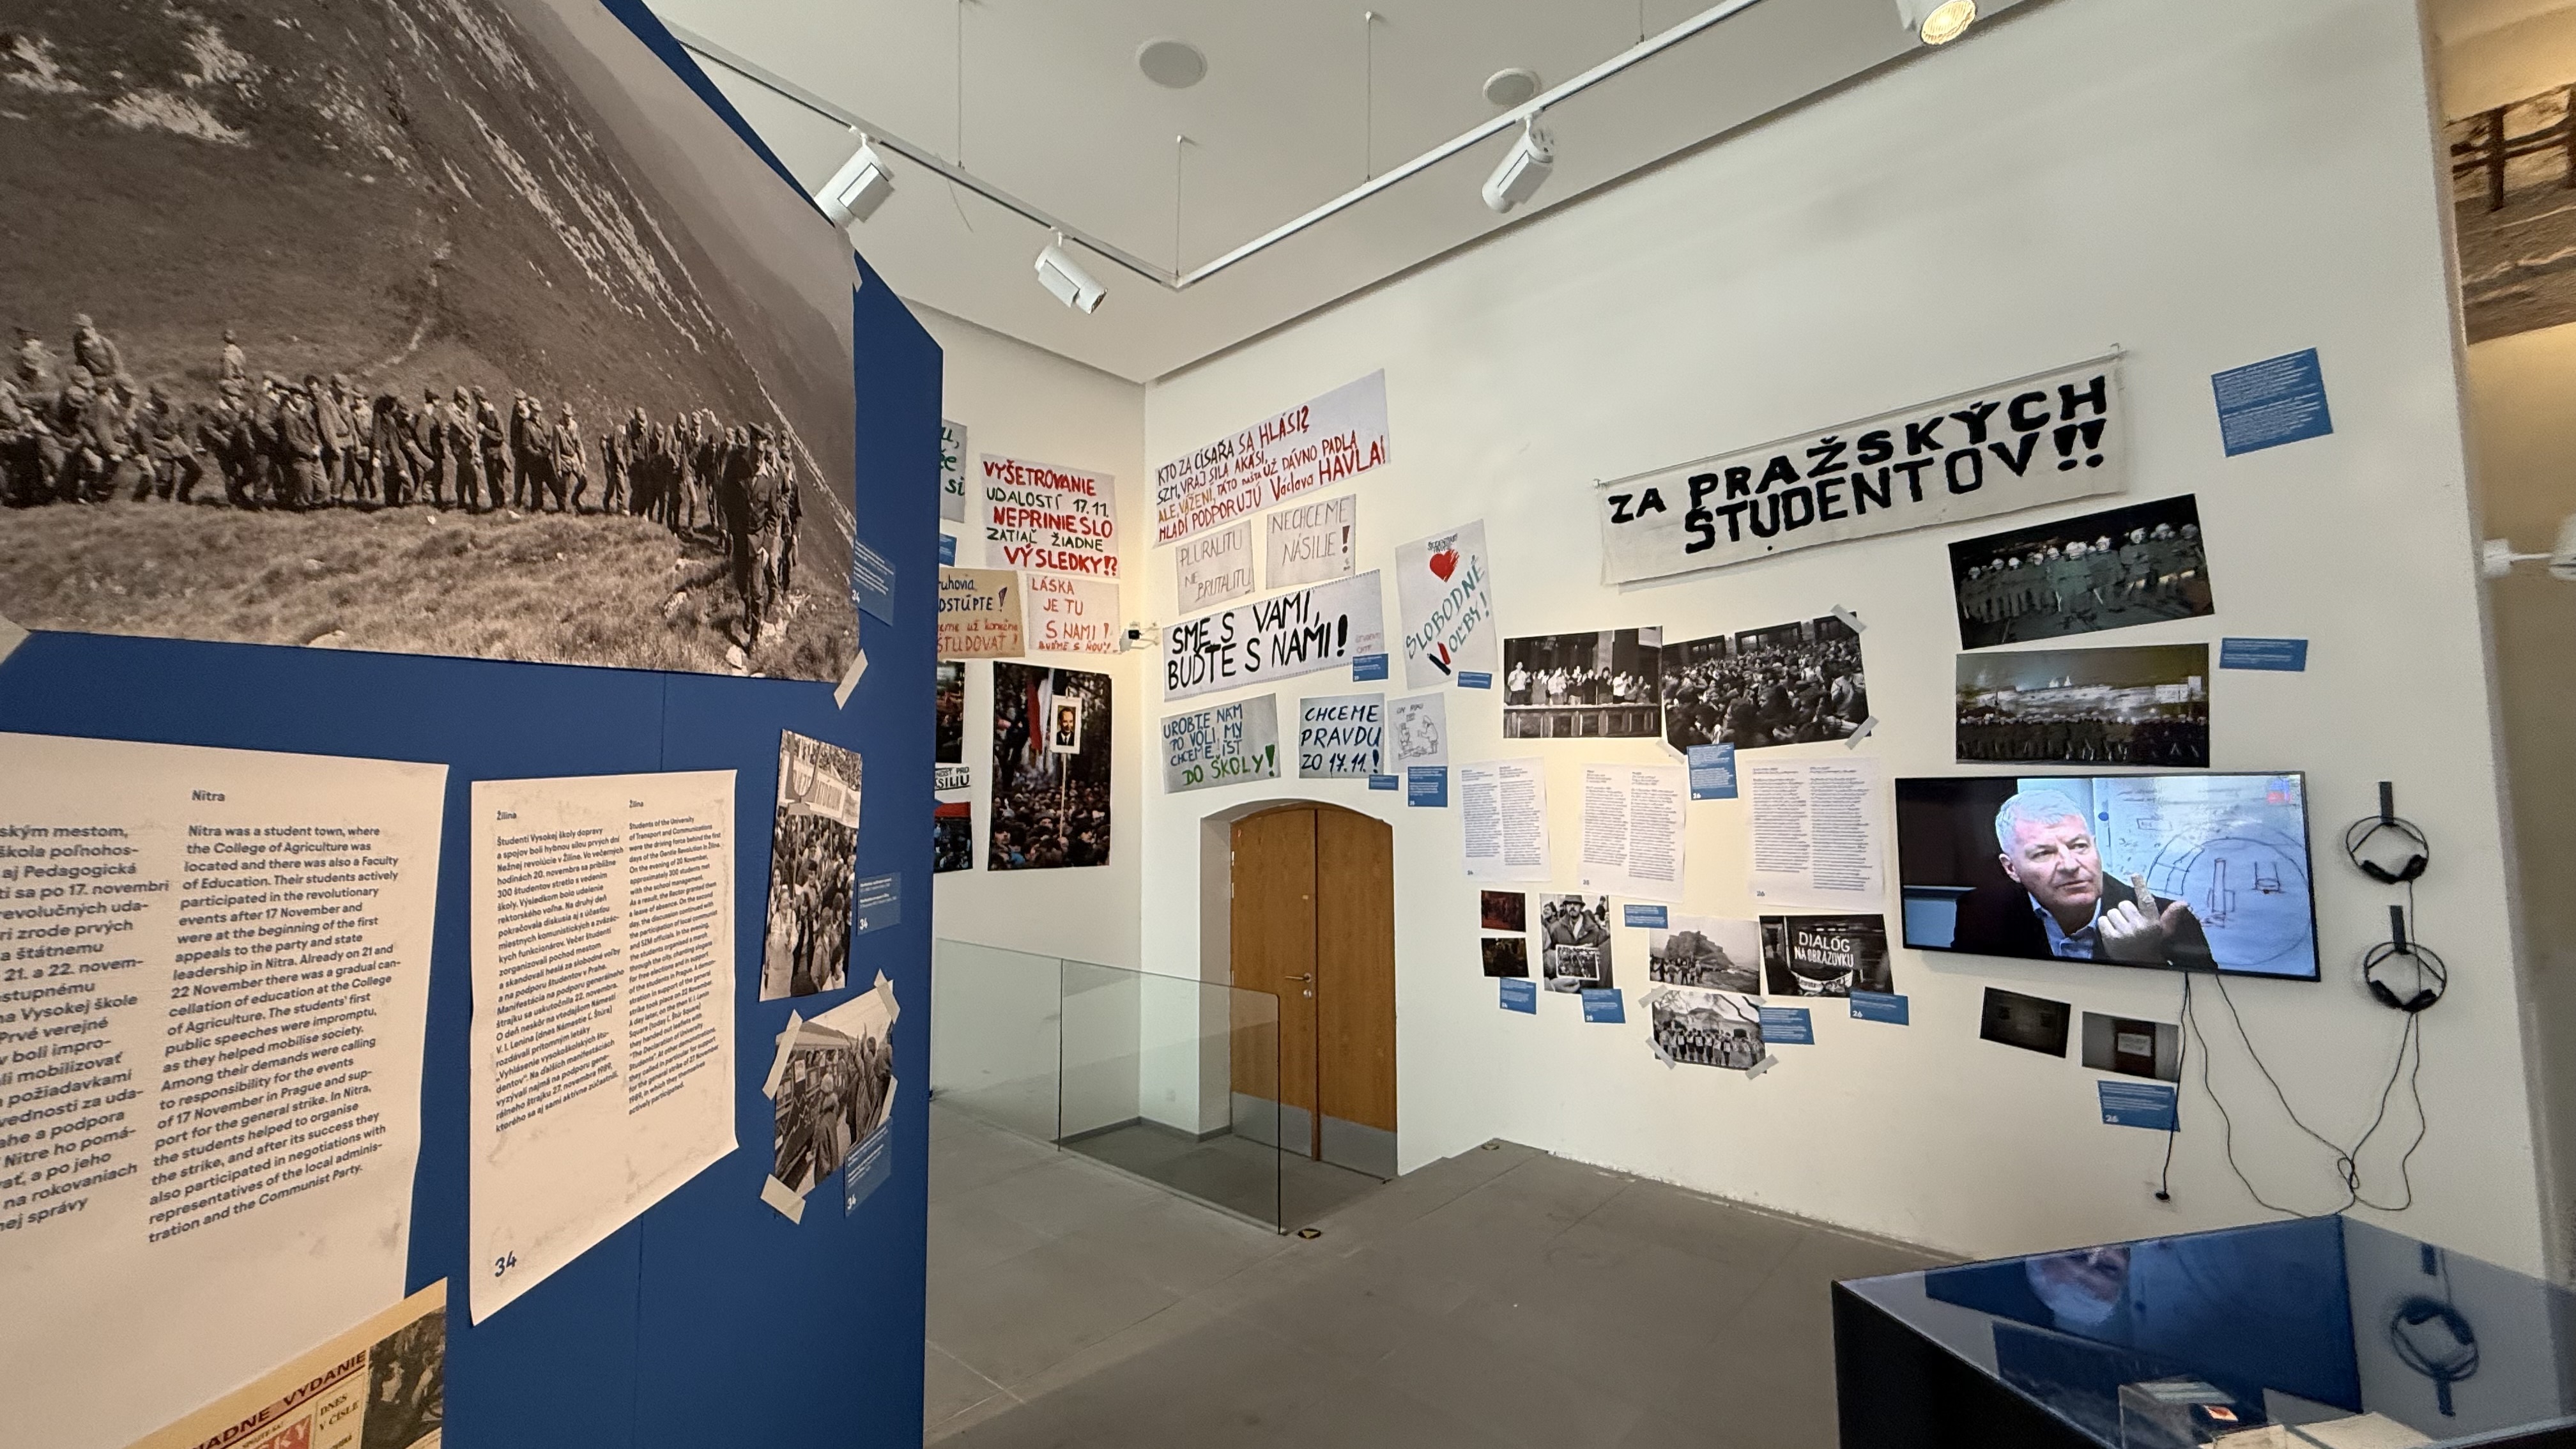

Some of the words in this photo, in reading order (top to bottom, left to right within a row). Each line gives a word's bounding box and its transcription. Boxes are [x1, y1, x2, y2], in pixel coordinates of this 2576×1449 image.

[1158, 463, 1176, 486] KTO
[1179, 457, 1192, 477] ZA
[1239, 431, 1255, 454] SA
[1259, 405, 1309, 448] HLÁSI?
[1607, 487, 1667, 523] ZA
[1689, 375, 2107, 507] PRAŽSKÝCH
[1217, 479, 1238, 496] TÁTO
[1282, 448, 1317, 471] DÁVNO
[1322, 429, 1358, 457] PADLA
[983, 459, 1096, 496] VYŠETROVANIE
[1158, 515, 1188, 542] MLADÍ
[1192, 481, 1262, 530] PODPORUJÚ
[1269, 471, 1314, 501] Václava
[1319, 434, 1386, 486] HAVLA!
[1181, 471, 1206, 494] VRAJ
[1209, 463, 1229, 482] SILA
[987, 487, 1062, 510] UDALOSTÍ
[1272, 497, 1350, 533] NECHCEME
[986, 527, 1038, 544] ZATIAĽ
[1051, 532, 1103, 552] ŽIADNE
[1180, 529, 1242, 567] PLURALITU
[1032, 576, 1075, 595] LÁSKA
[1185, 571, 1199, 587] NE
[939, 594, 993, 613] DSTÚPTE
[1043, 598, 1059, 612] JE
[1064, 598, 1084, 616] TU
[1406, 554, 1485, 659] SLOBODNÉ
[940, 624, 959, 632] eme
[1046, 620, 1057, 639] S
[1064, 622, 1095, 640] NAMI
[1172, 617, 1211, 655] SME
[1220, 612, 1235, 643] S
[1245, 638, 1261, 672] S
[1305, 705, 1379, 722] CHCEME
[1163, 712, 1211, 739] UROBTE
[1170, 737, 1184, 751] PO
[1301, 726, 1381, 748] PRAVDU
[1301, 754, 1322, 770] ZO
[1182, 764, 1204, 786] DO
[192, 790, 226, 802] Nitra
[496, 810, 517, 820] Žilina
[629, 820, 654, 830] Students
[0, 824, 49, 841] ským
[53, 826, 128, 838] mestom,
[188, 825, 222, 836] Nitra
[225, 828, 250, 836] was
[253, 828, 261, 836] a
[263, 826, 312, 836] student
[314, 827, 346, 838] town,
[348, 826, 380, 836] where
[497, 836, 529, 847] Študenti
[530, 832, 558, 843] Vysokej
[559, 830, 576, 839] školy
[577, 827, 603, 837] dopravy
[187, 843, 211, 854] the
[213, 842, 266, 855] College
[268, 842, 282, 853] of
[283, 842, 348, 855] Agriculture
[3, 866, 19, 881] aj
[24, 862, 137, 878] Pedagogická
[183, 859, 238, 872] located
[241, 859, 266, 870] and
[269, 858, 302, 869] there
[304, 859, 326, 868] was
[328, 857, 351, 867] also
[362, 855, 399, 867] Faculty
[0, 886, 11, 899] ti
[15, 888, 35, 898] sa
[40, 887, 64, 900] po
[68, 883, 88, 896] 17.
[92, 880, 170, 894] novembri
[182, 879, 199, 890] of
[201, 877, 272, 889] Education.
[273, 874, 305, 885] Their
[306, 873, 355, 884] students
[358, 870, 399, 882] actively
[1799, 931, 1850, 953] DIALÓG
[1794, 946, 1807, 960] NA
[1807, 949, 1853, 967] OBRAZOVKU
[148, 1218, 201, 1243] tration
[202, 1208, 230, 1225] and
[233, 1197, 256, 1215] the
[258, 1173, 331, 1205] Communist
[332, 1163, 364, 1181] Party.
[0, 1213, 23, 1231] nej
[27, 1197, 88, 1223] správy
[495, 1250, 517, 1277] 34
[283, 1349, 367, 1406] VYDANIE
